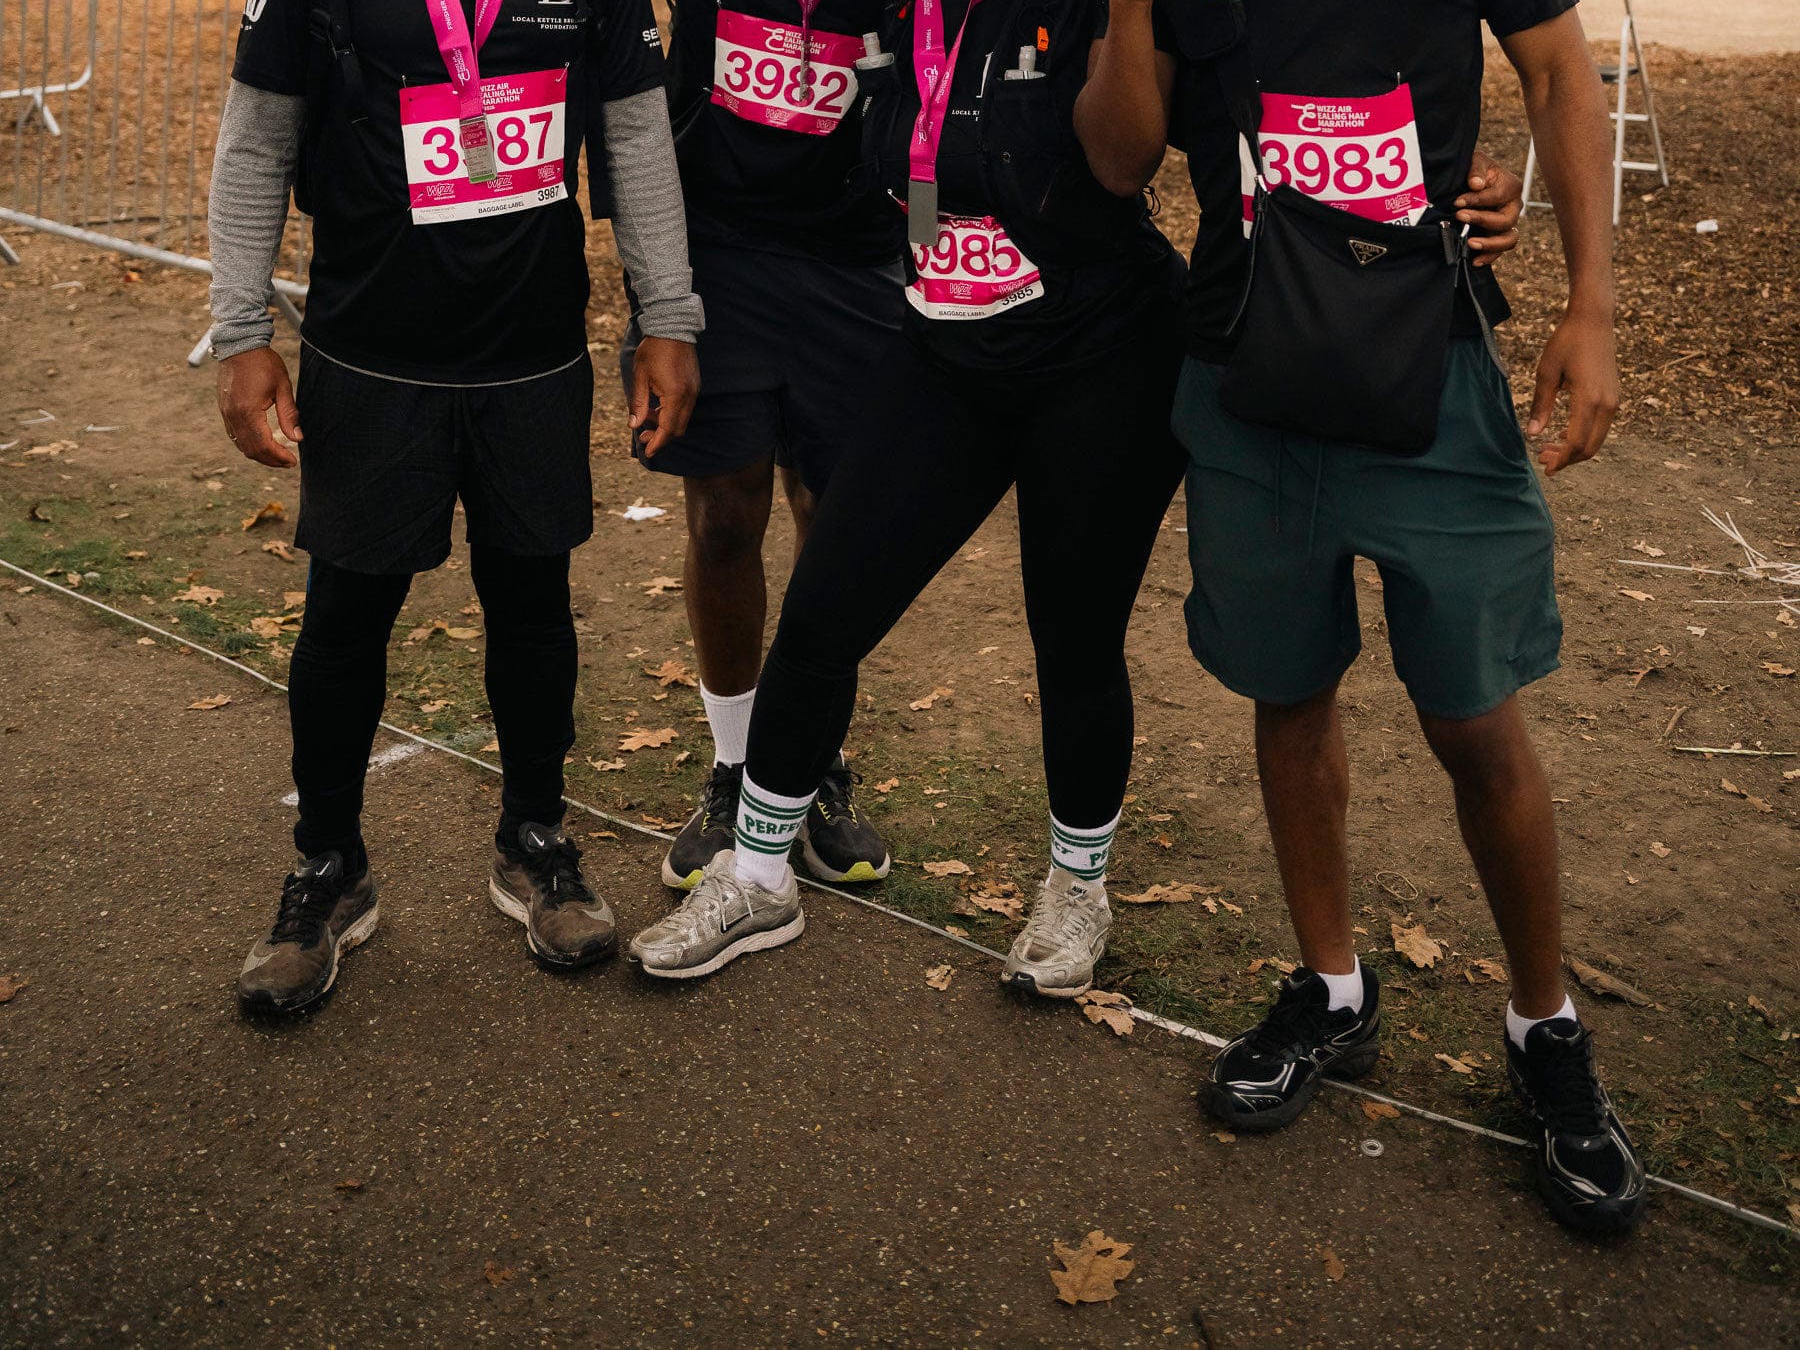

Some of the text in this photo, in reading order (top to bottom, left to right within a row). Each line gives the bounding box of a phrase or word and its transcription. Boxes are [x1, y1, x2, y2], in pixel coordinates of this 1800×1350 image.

[785, 30, 802, 39] WIZZ
[497, 82, 509, 91] AIR
[724, 50, 848, 114] 3982
[483, 87, 525, 99] ALING HALF
[1316, 105, 1352, 113] WIZZ AIR
[1317, 111, 1371, 120] EALING HALF
[1317, 119, 1365, 128] MARATHON
[422, 111, 554, 176] 387
[1259, 137, 1409, 195] 3983
[537, 185, 560, 202] 3987
[478, 201, 525, 214] BAGGAGE LABEL
[1002, 285, 1034, 306] 3985
